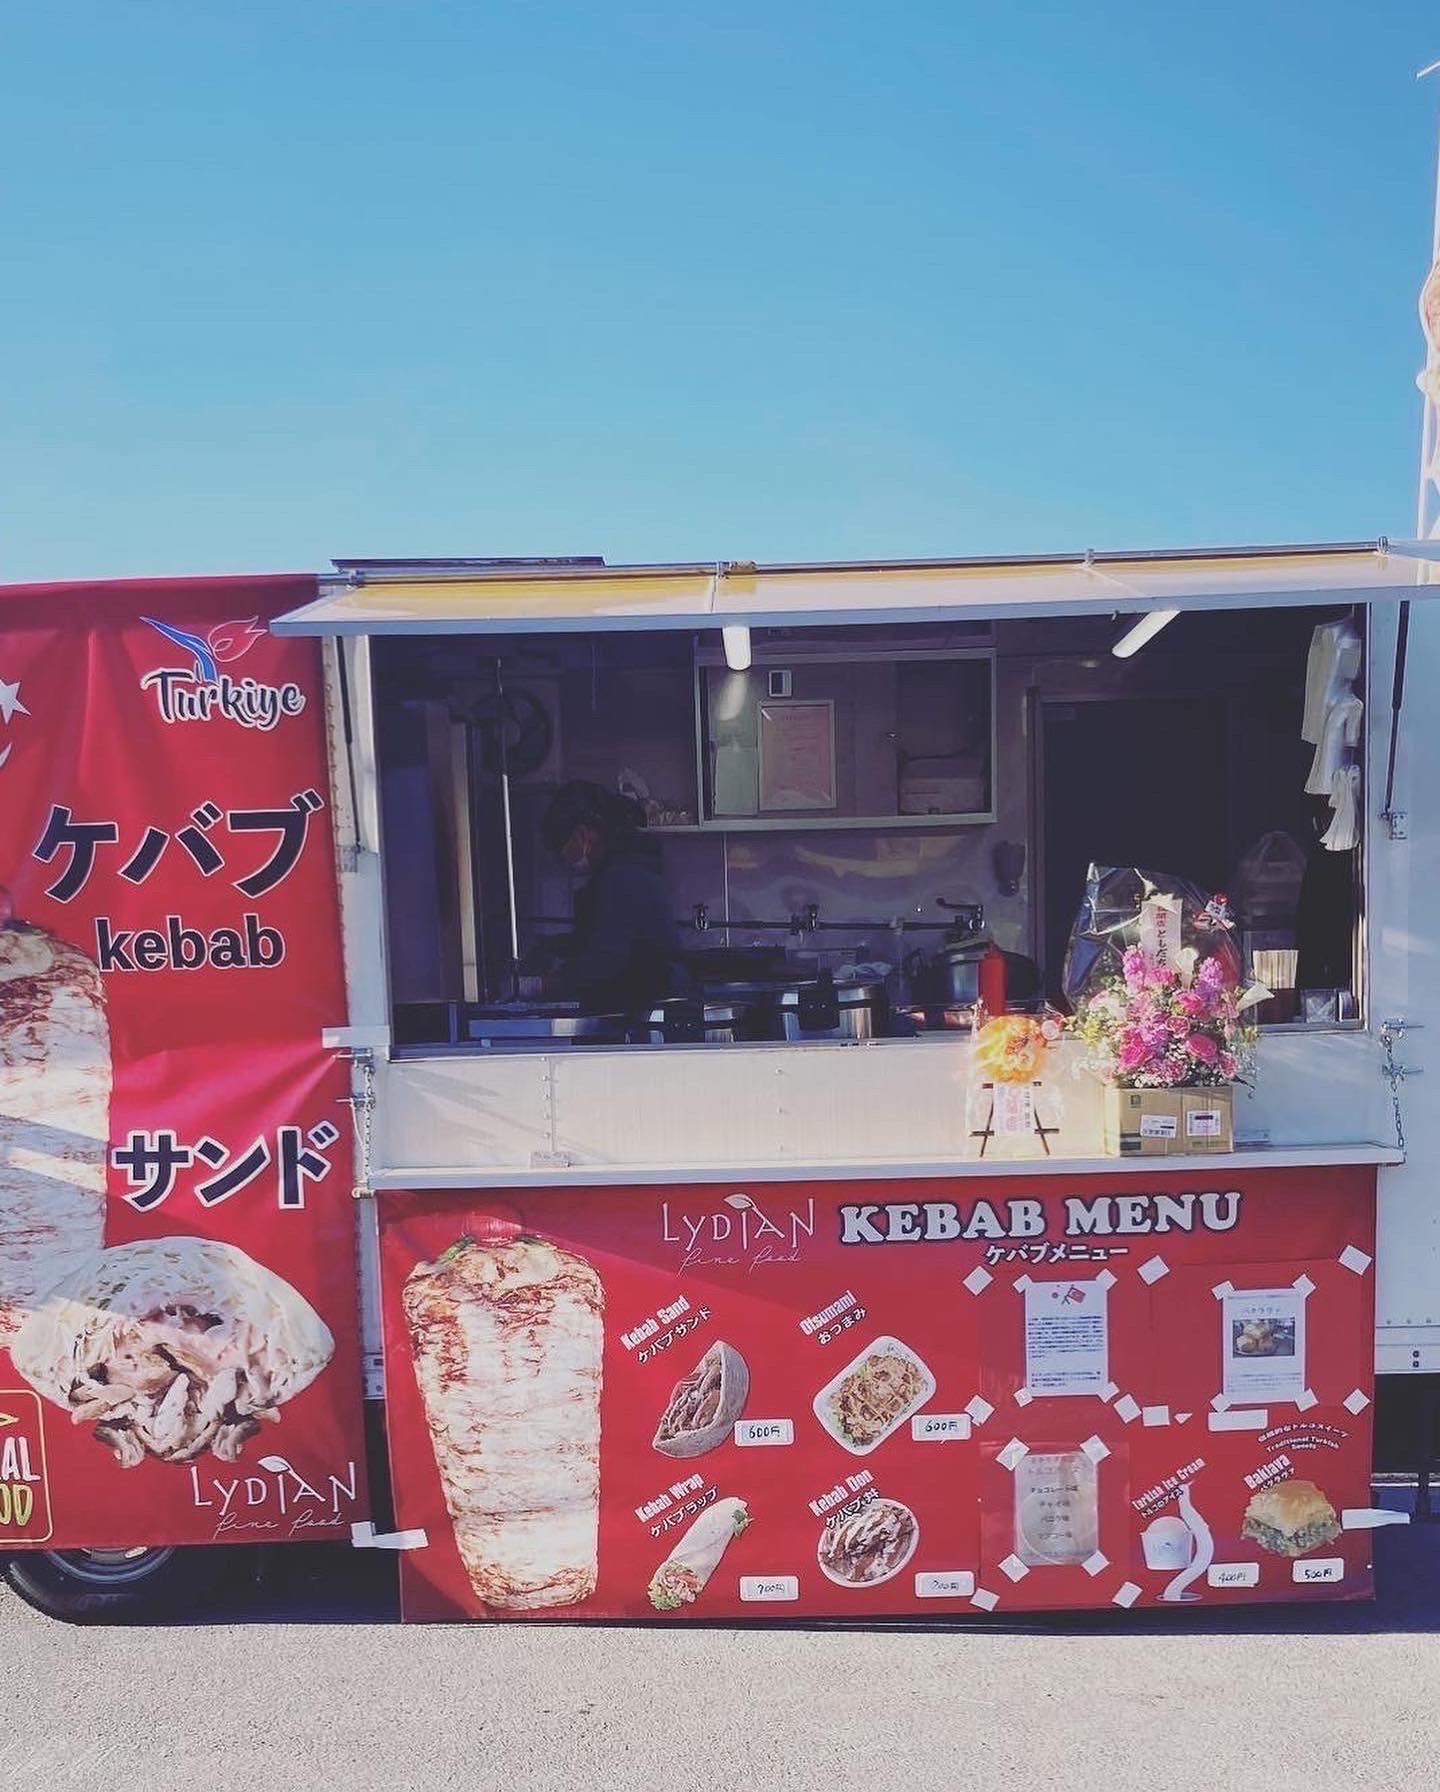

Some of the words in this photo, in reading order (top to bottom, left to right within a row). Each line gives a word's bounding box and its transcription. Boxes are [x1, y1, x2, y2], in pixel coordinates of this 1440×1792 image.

[32, 789, 325, 903] ケバブ
[96, 913, 285, 973] kebab
[111, 1120, 340, 1211] サンド
[840, 1199, 1046, 1243] KEBAB
[1065, 1191, 1242, 1234] MENU
[985, 1242, 1129, 1266] ケバブメニュー
[620, 1318, 660, 1351] Kebab
[656, 1294, 691, 1325] Sand
[638, 1305, 712, 1363] ケバブサンド
[818, 1308, 866, 1344] おつまみ
[0, 1437, 41, 1482] AL
[1243, 1454, 1292, 1490] Baklava
[634, 1494, 673, 1523] Kebab
[668, 1473, 705, 1501] Wrap
[808, 1485, 849, 1517] Kebab
